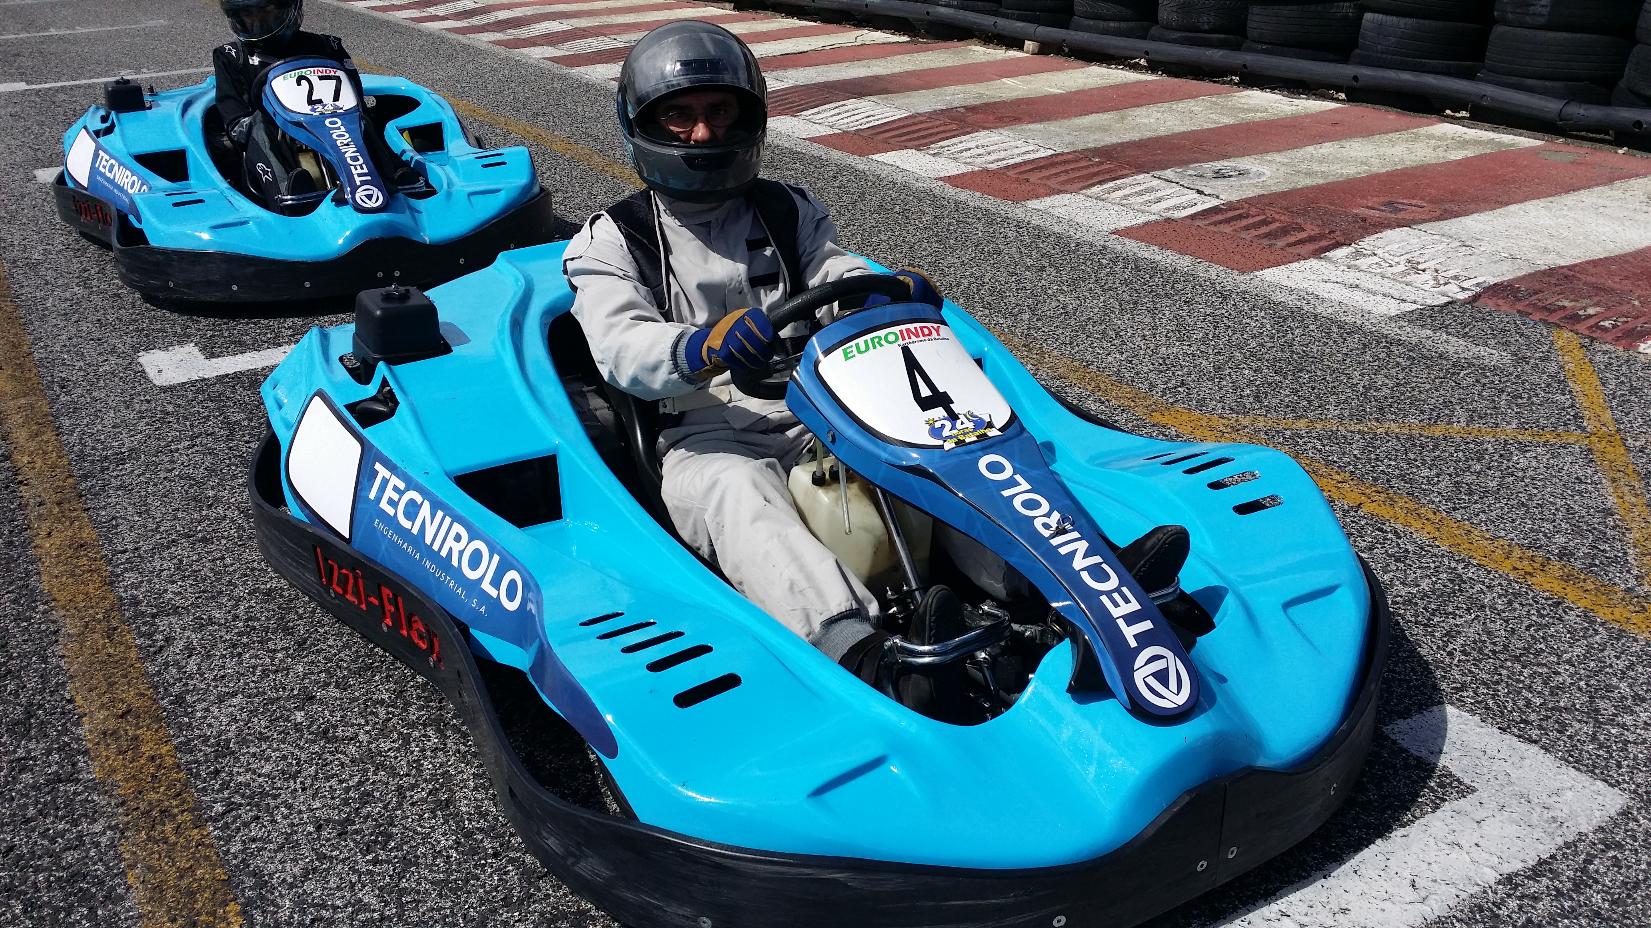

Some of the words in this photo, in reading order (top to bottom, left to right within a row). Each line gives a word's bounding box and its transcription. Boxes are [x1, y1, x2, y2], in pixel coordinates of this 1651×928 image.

[283, 69, 338, 81] EUROINDY
[296, 75, 343, 106] 27
[325, 117, 372, 186] TECNIROLO
[841, 325, 942, 362] EUROINDY
[901, 346, 959, 422] 4
[934, 414, 976, 438] 24
[368, 461, 523, 612] TECNIROLO
[373, 519, 420, 560] ENGENHARIA
[421, 557, 469, 603] INDUSTRIAL,
[978, 453, 1155, 648] TECNIROLO
